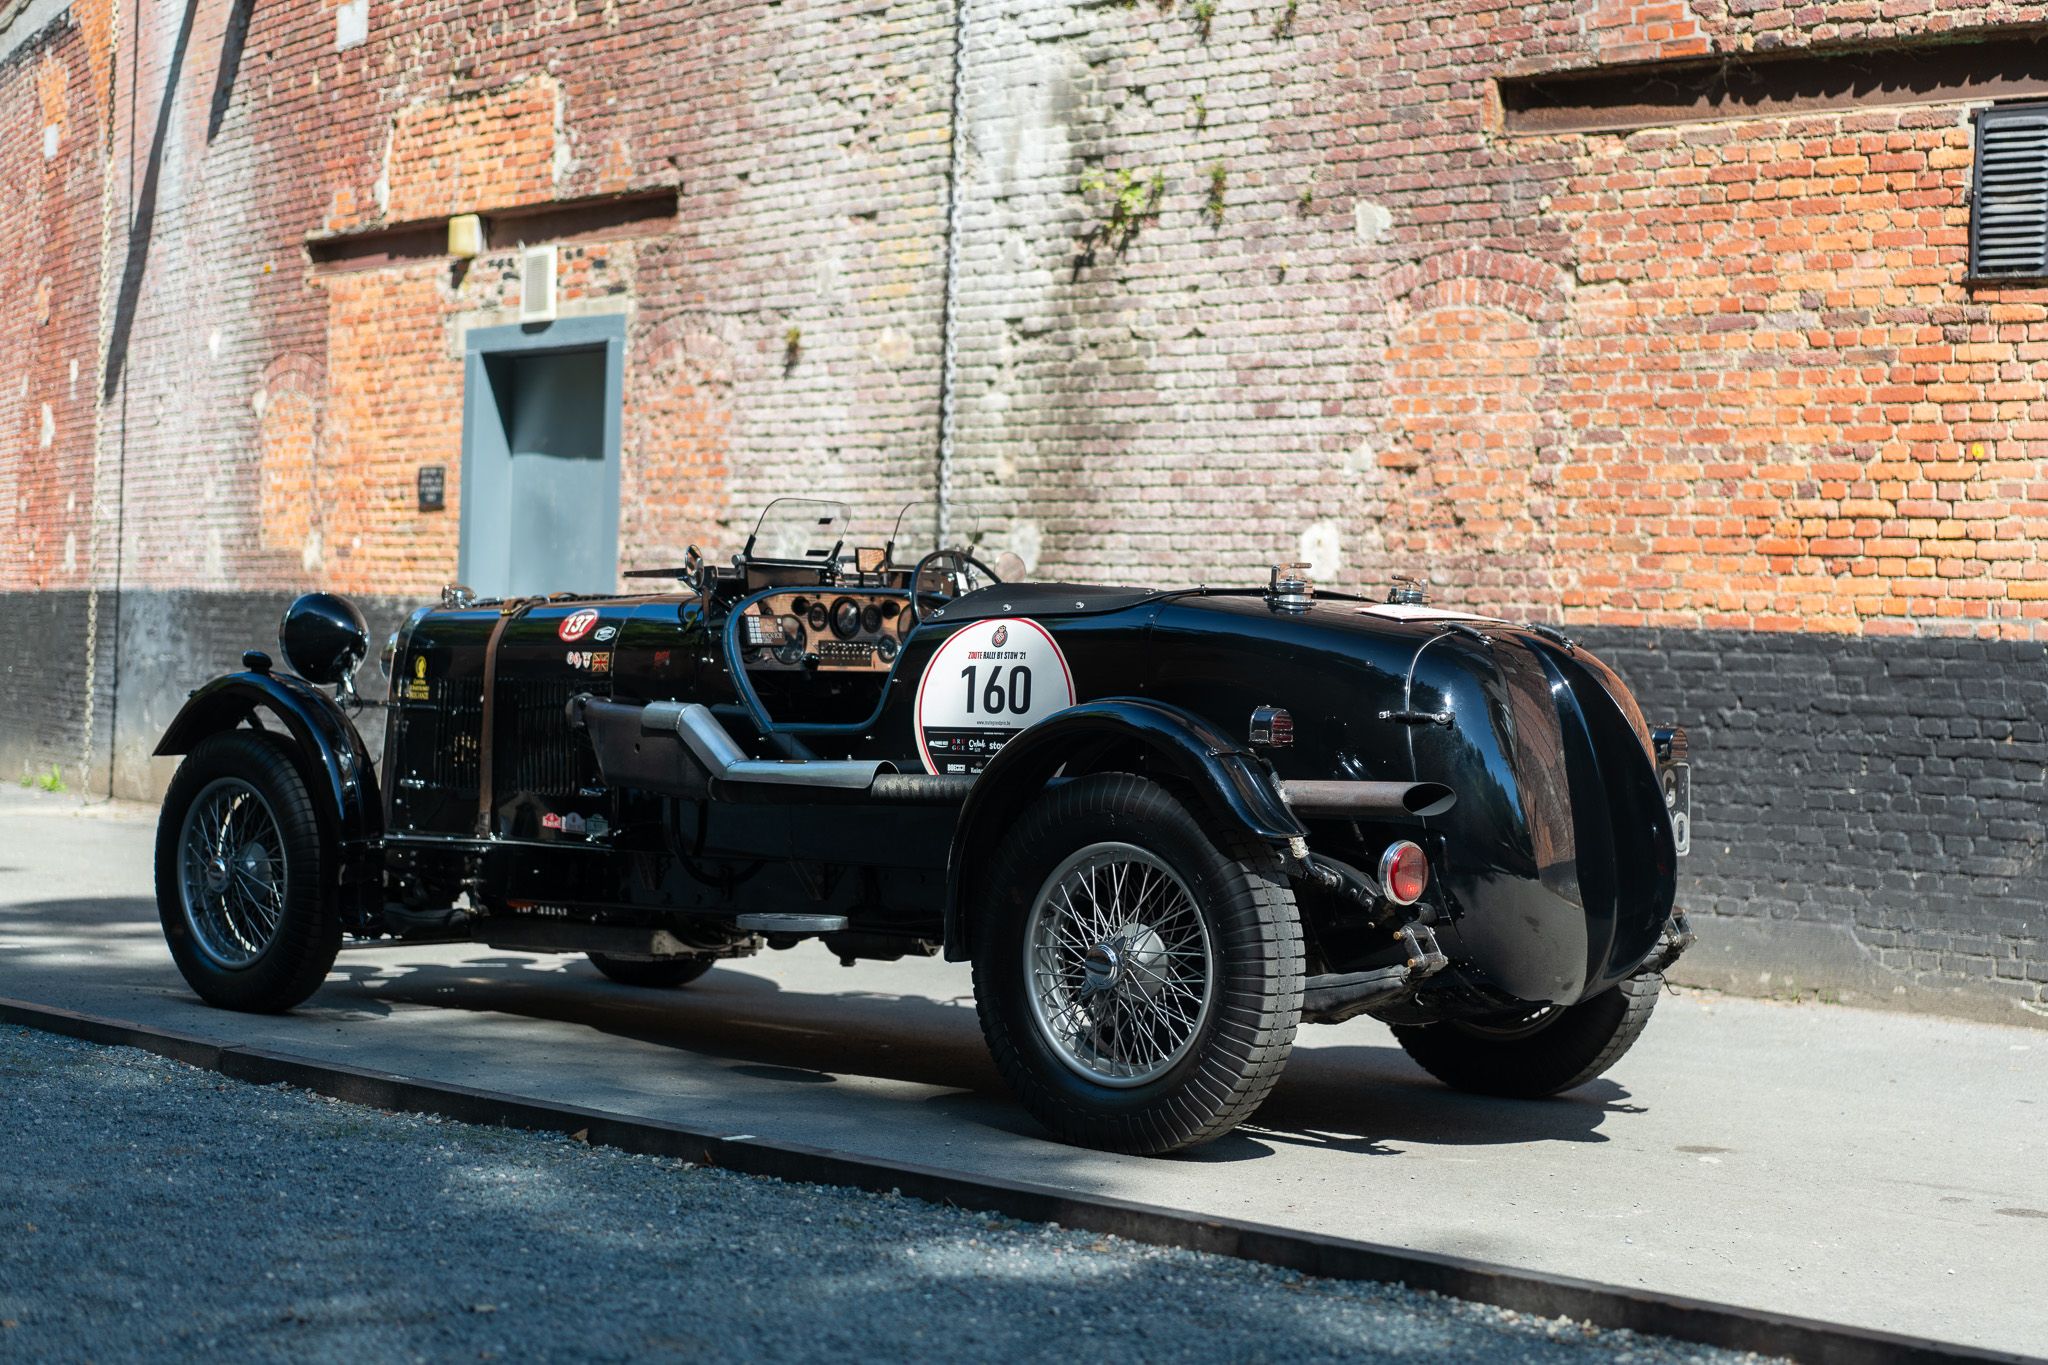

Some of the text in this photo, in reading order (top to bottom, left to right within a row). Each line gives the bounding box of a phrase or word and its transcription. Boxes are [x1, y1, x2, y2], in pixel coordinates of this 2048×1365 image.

[564, 614, 595, 634] 137
[967, 651, 983, 660] ZOUTE
[983, 651, 996, 660] RALLY
[996, 651, 1003, 660] BY
[1004, 651, 1018, 660] STOW
[961, 665, 1032, 715] 160
